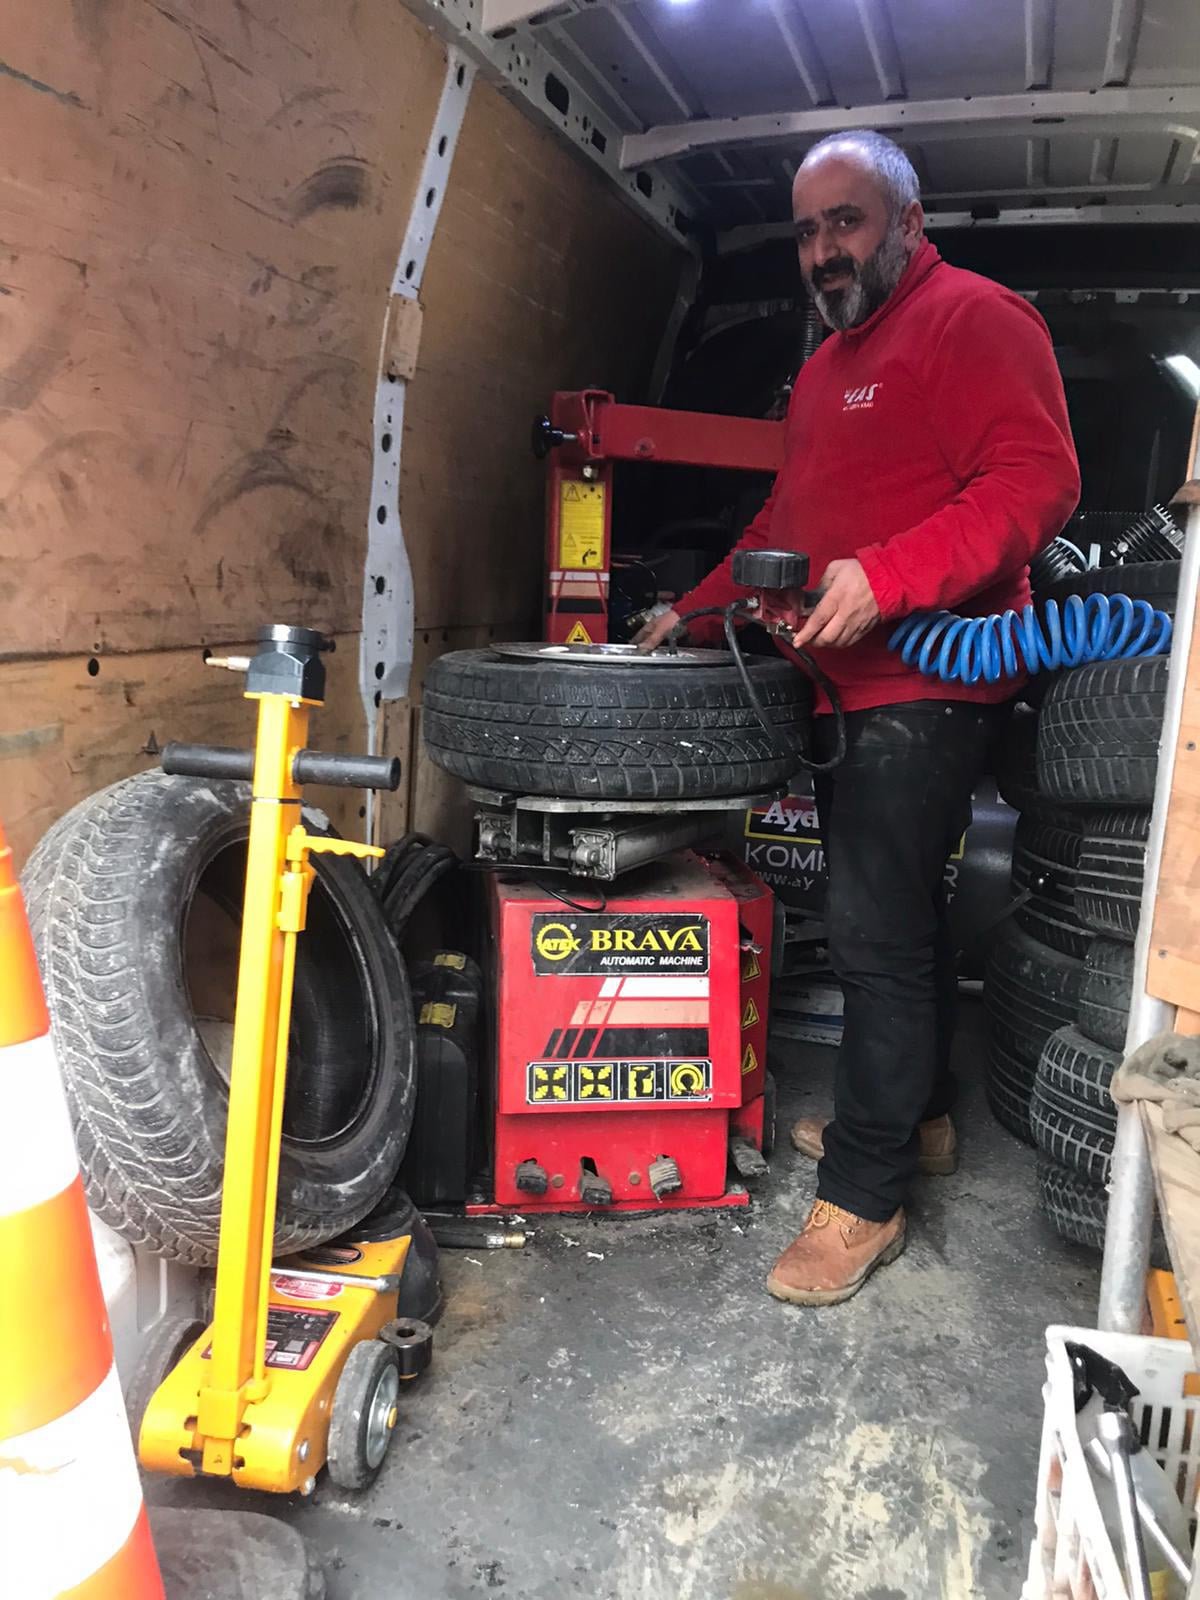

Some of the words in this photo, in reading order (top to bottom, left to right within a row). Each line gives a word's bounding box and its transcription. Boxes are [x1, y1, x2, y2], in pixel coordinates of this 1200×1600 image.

[541, 937, 582, 951] ATEK
[590, 926, 704, 951] BRAVA
[600, 956, 655, 966] AUTOMATIC
[659, 957, 703, 966] MACHINE
